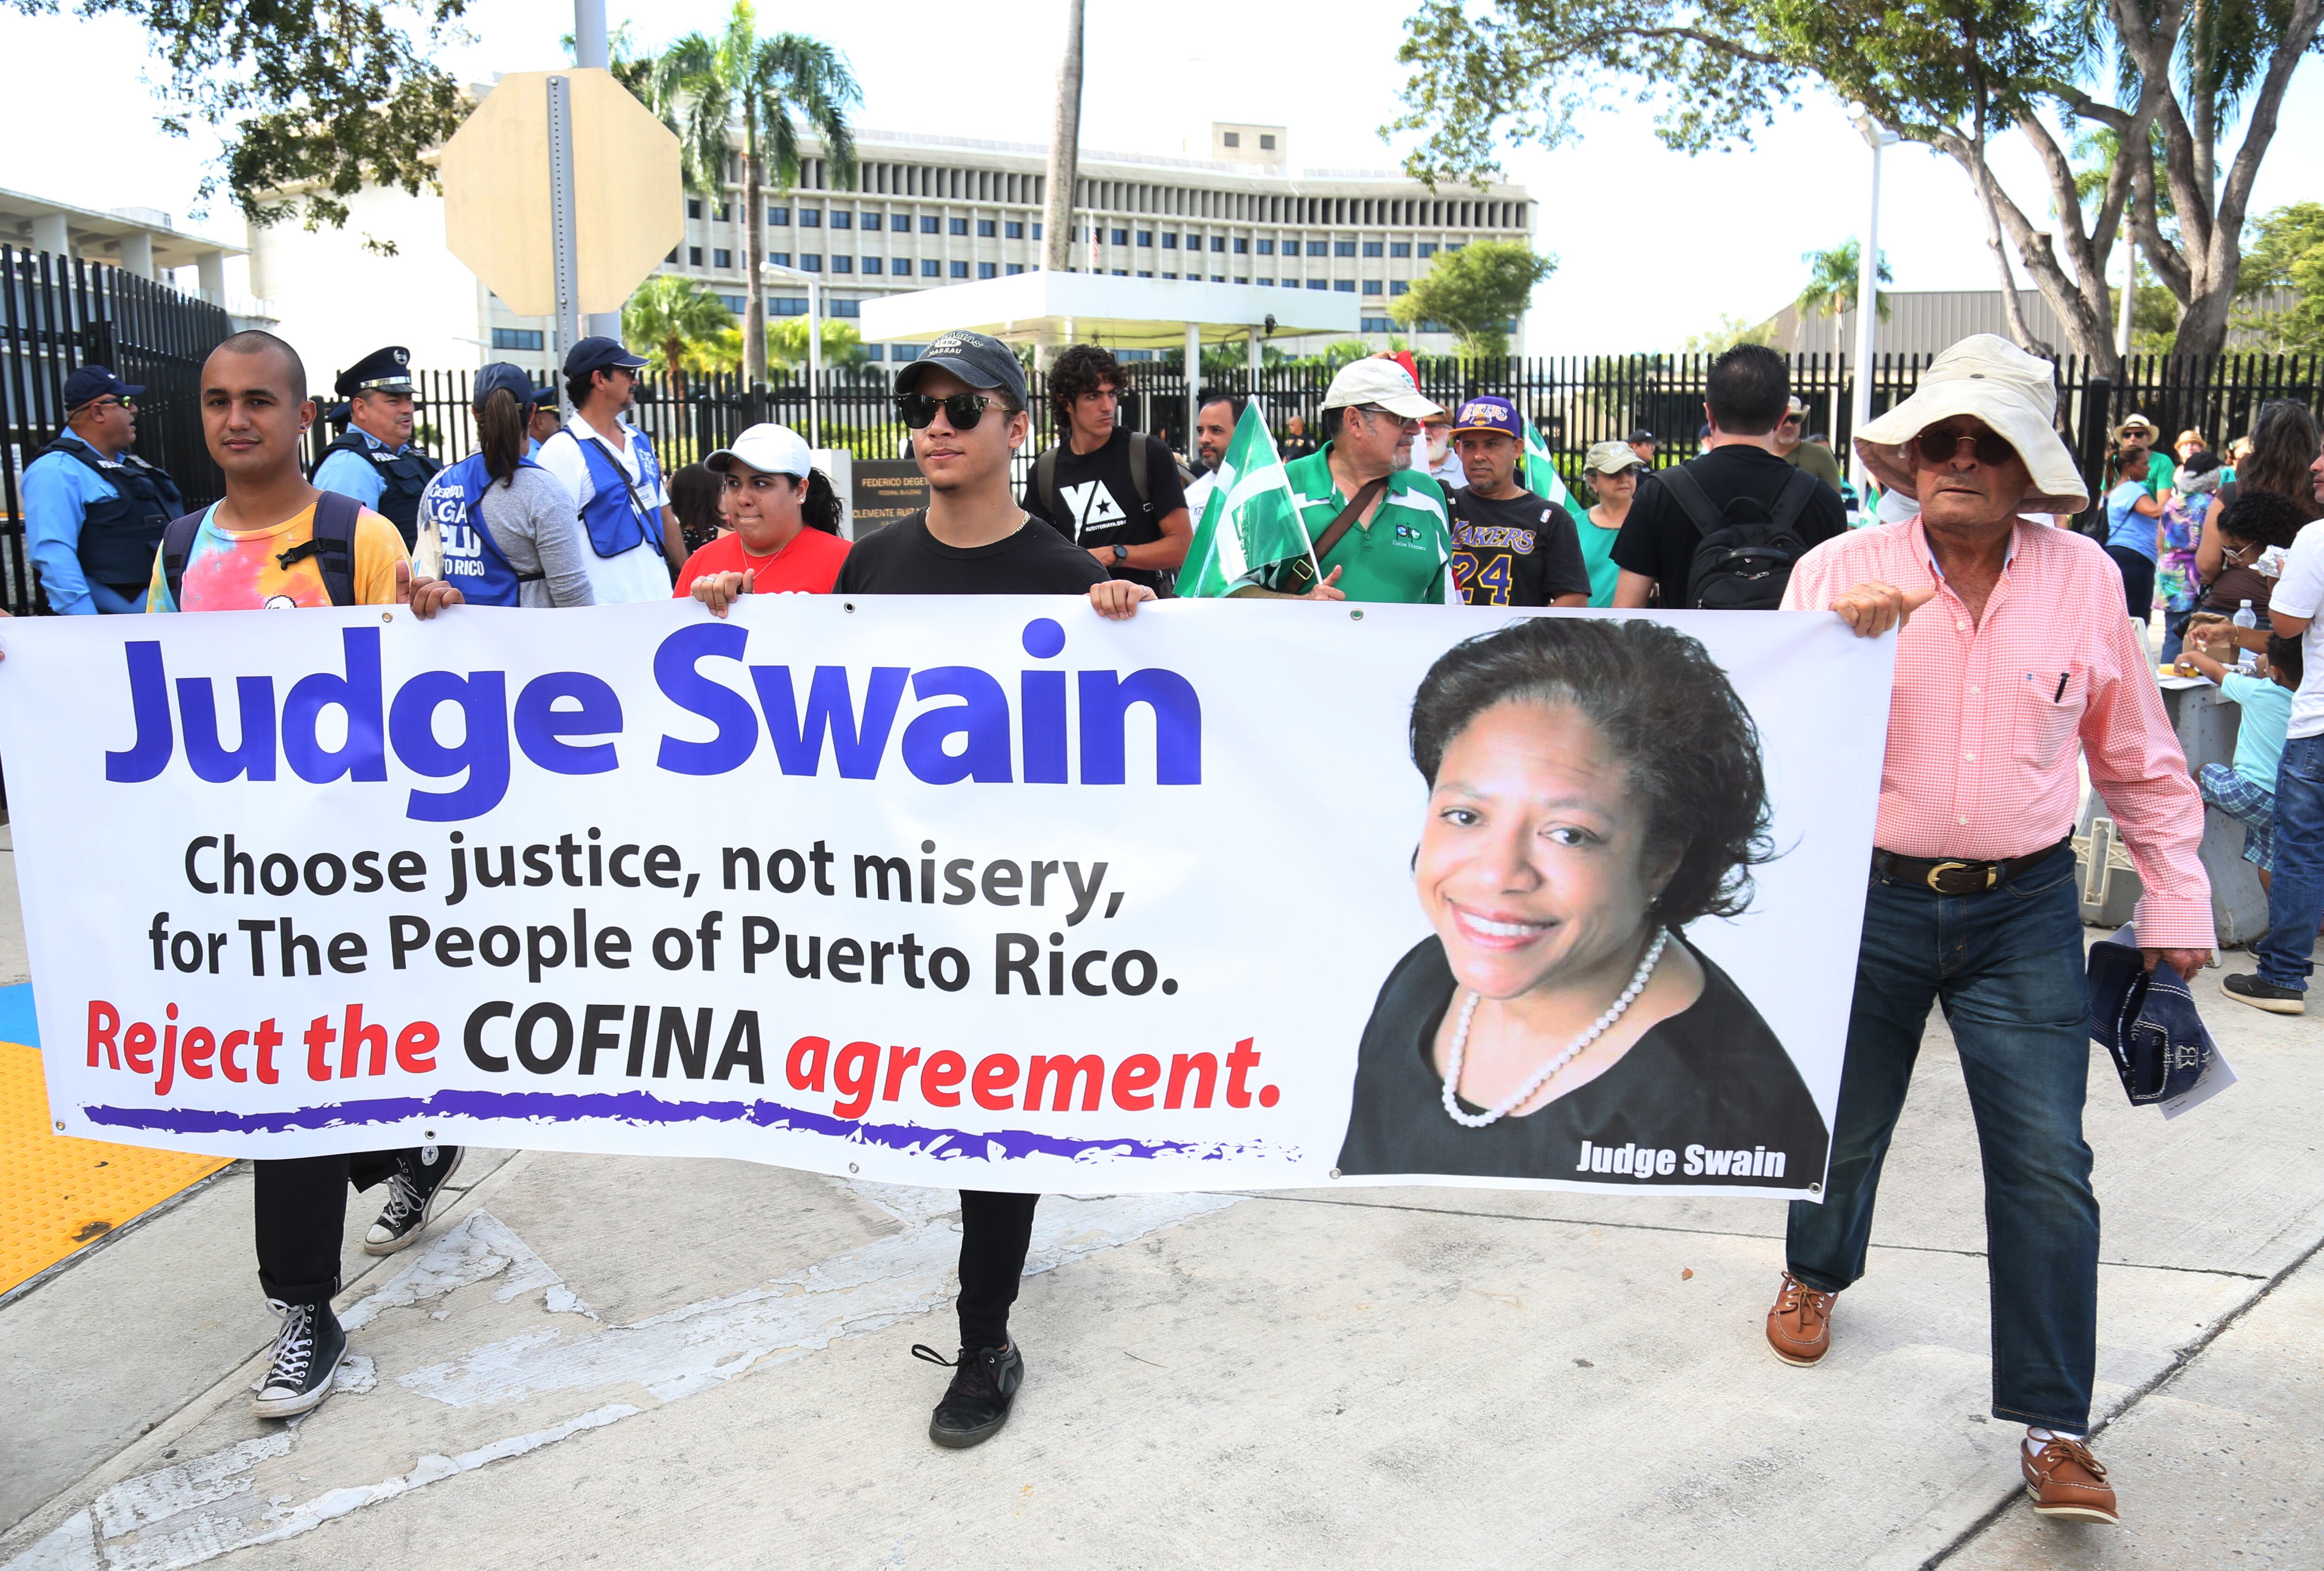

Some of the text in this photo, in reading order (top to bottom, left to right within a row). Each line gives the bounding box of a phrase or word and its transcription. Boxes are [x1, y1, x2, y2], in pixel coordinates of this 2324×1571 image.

[928, 348, 962, 357] NASSAU
[1459, 403, 1508, 423] LAKERS
[862, 478, 902, 487] FEDERICO
[853, 509, 895, 518] CLEMENTE
[1451, 517, 1536, 555] LAKERS
[454, 559, 485, 577] RICO
[1452, 551, 1513, 605] 24
[105, 617, 1202, 822] Judge Swain
[185, 830, 1125, 927] Choose justice, not misery,
[149, 908, 1178, 997] for The People of Puerto Rico.
[87, 1000, 1280, 1120] Reject the COFINA agreement.
[1576, 1140, 1787, 1179] Judge Swain
